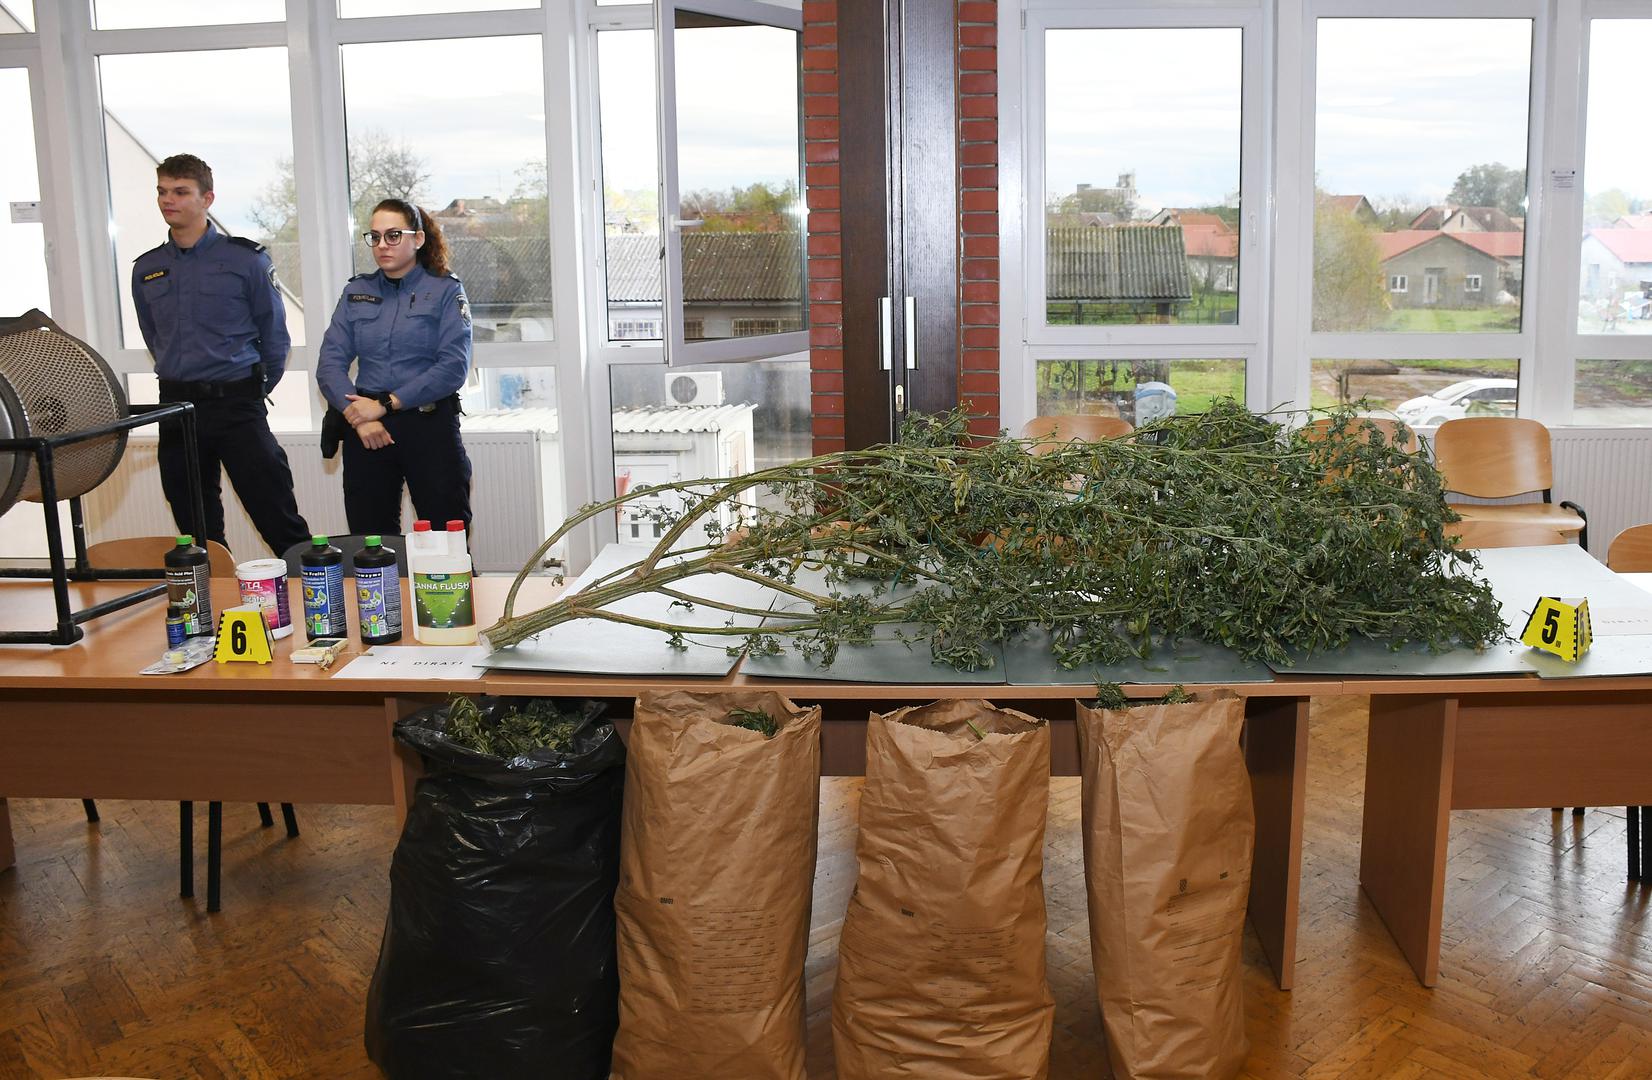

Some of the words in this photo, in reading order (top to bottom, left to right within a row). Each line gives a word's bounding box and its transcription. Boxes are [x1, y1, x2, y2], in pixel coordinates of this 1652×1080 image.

[440, 582, 470, 590] FLUSH
[231, 620, 247, 655] 6
[1541, 607, 1561, 645] 5
